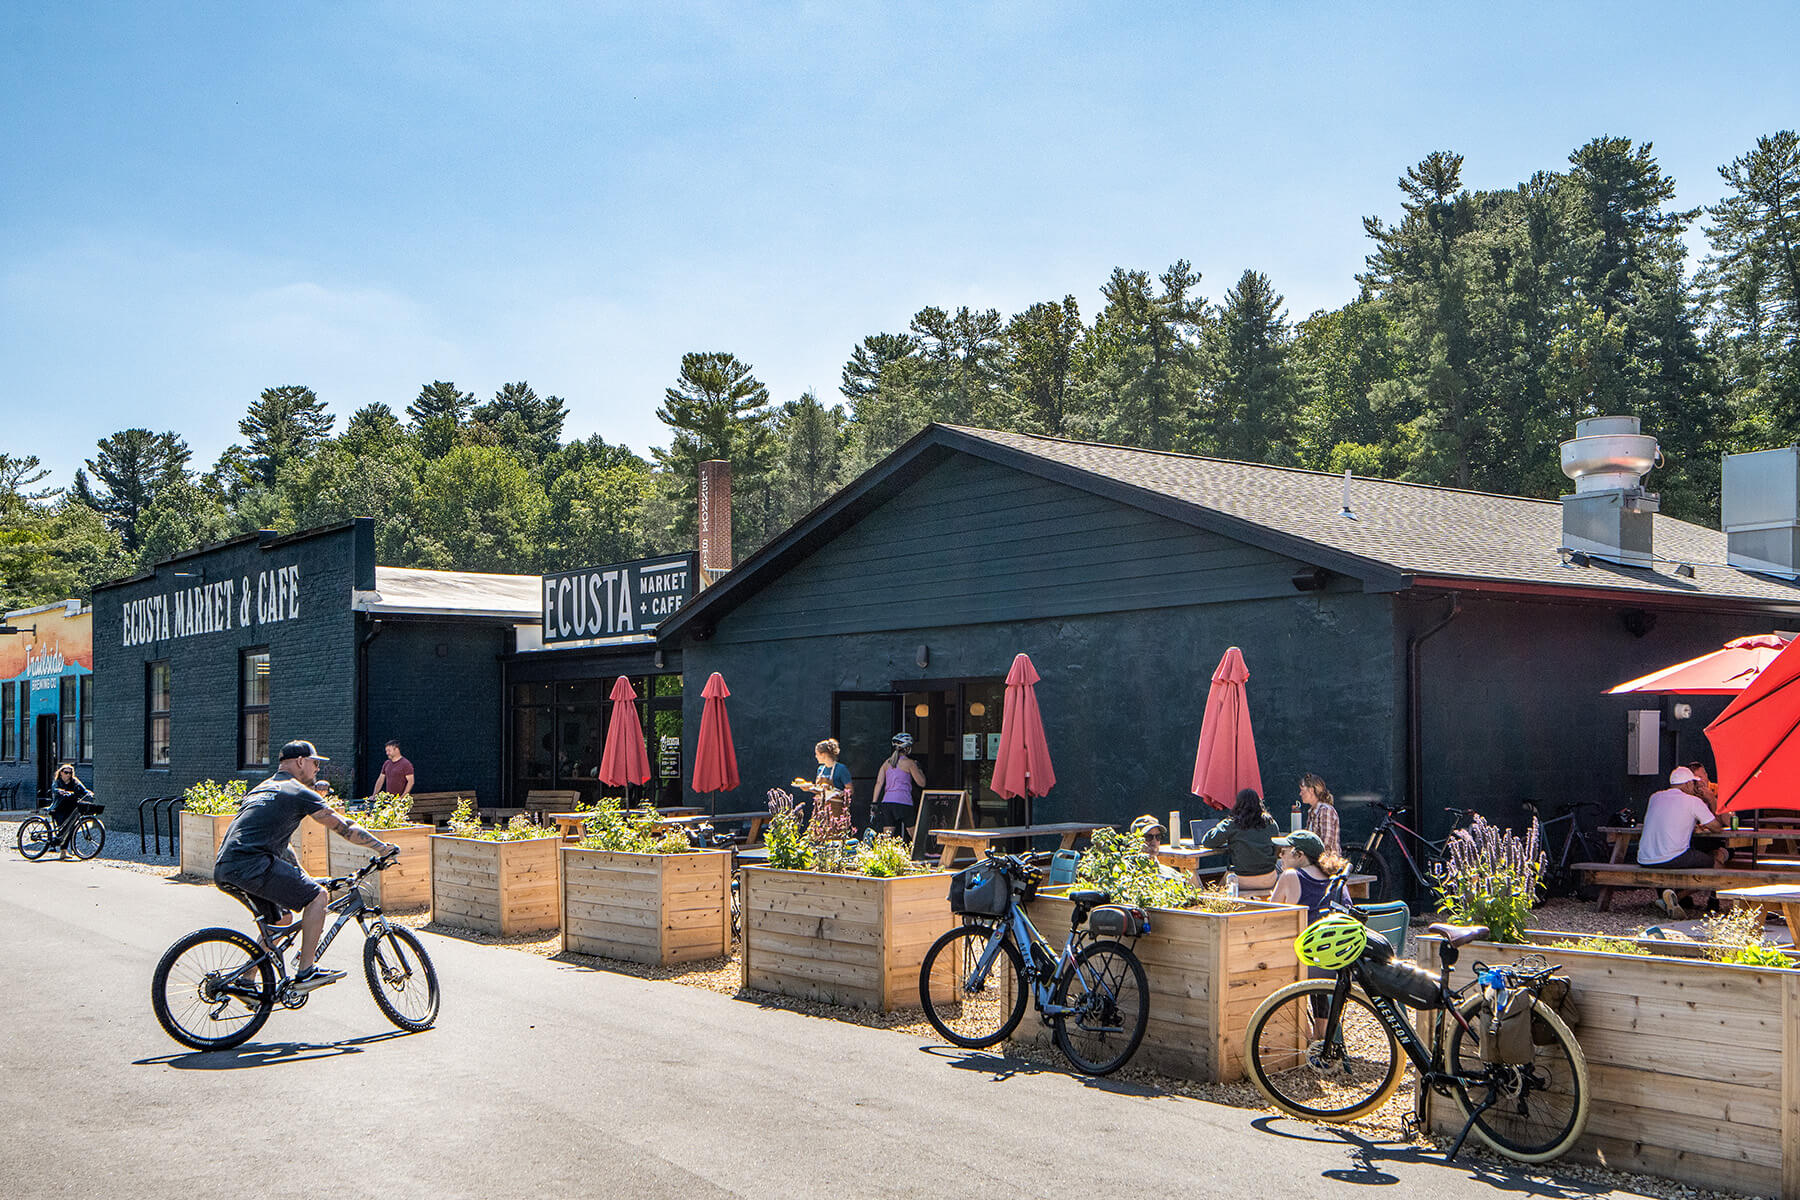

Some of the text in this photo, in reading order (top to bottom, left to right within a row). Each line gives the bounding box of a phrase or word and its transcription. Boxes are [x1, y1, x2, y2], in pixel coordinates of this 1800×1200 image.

[545, 568, 634, 639] ECUSTA
[640, 571, 687, 594] MARKET
[122, 564, 300, 647] ECUSTA MARKET & CAFE
[652, 595, 683, 615] CAFE
[25, 640, 65, 678] Trailside
[1371, 996, 1411, 1044] AVENTON
